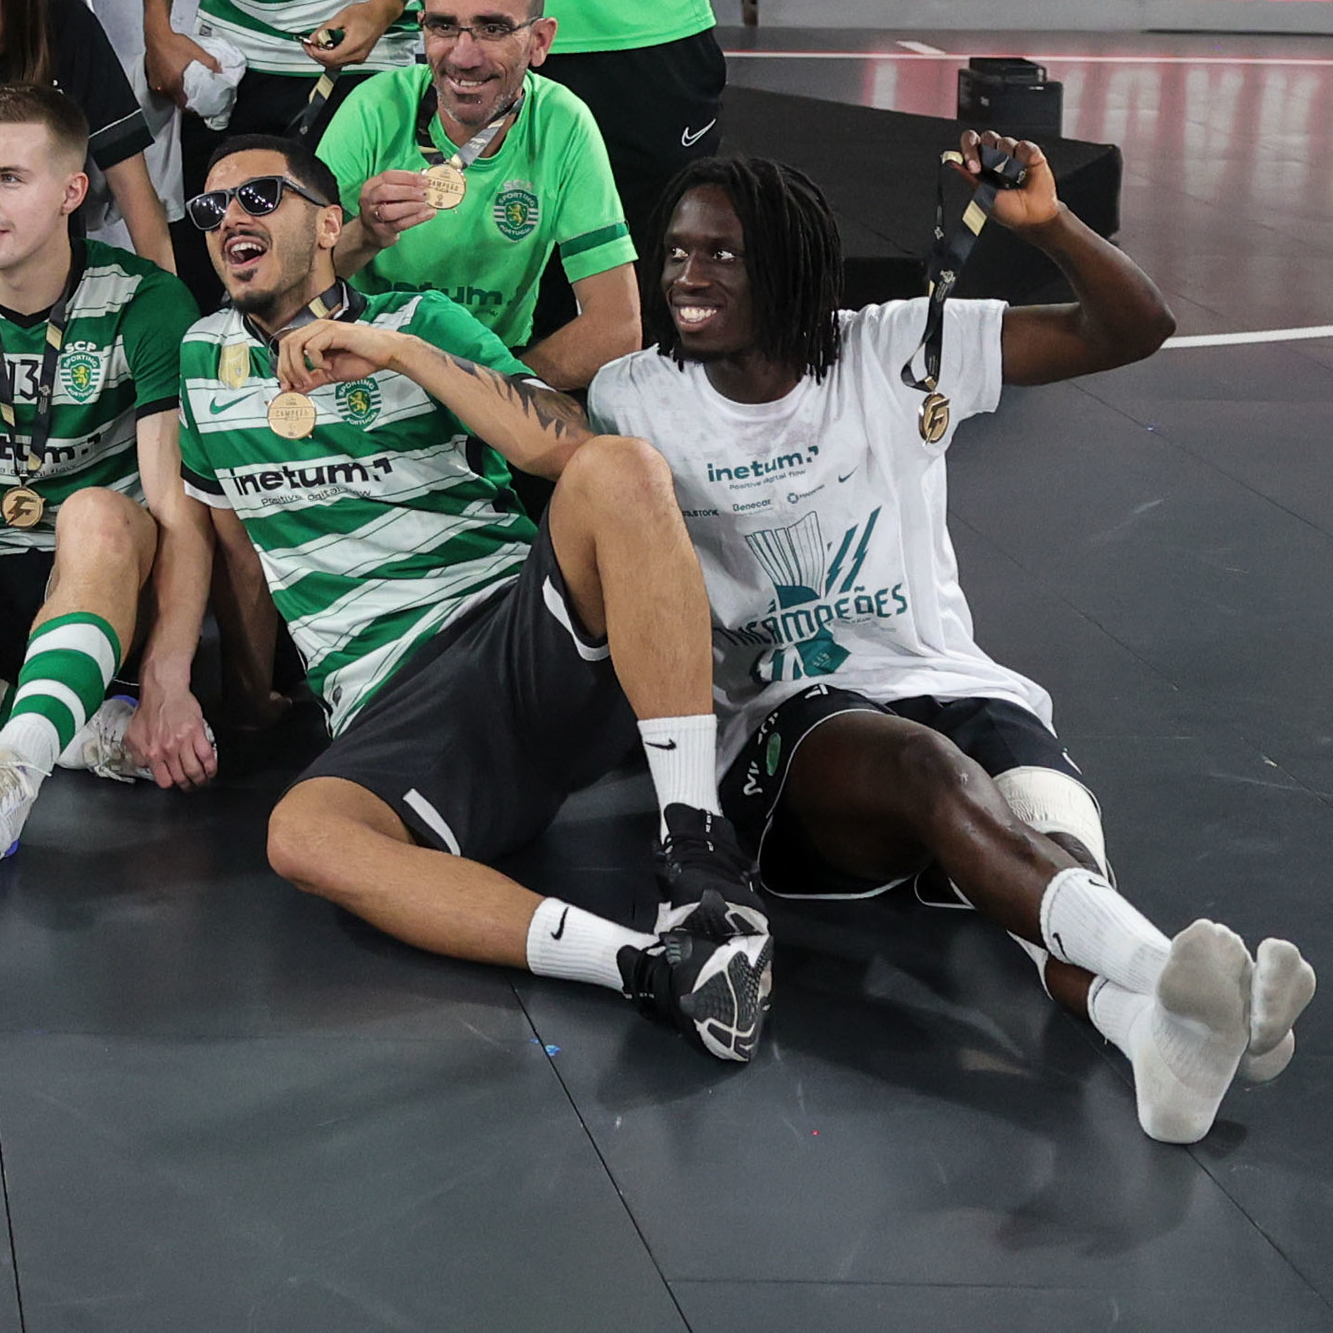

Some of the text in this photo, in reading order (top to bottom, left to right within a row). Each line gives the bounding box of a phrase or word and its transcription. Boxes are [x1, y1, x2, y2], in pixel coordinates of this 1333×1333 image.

[499, 191, 536, 206] SPORTING
[64, 341, 97, 353] SCP
[63, 355, 98, 369] SPORTING
[7, 359, 39, 401] 13
[338, 379, 375, 396] SPORTING
[346, 412, 377, 426] PORTUGAL
[729, 479, 761, 490] Positive
[788, 468, 806, 479] flow
[732, 498, 772, 513] Benecar
